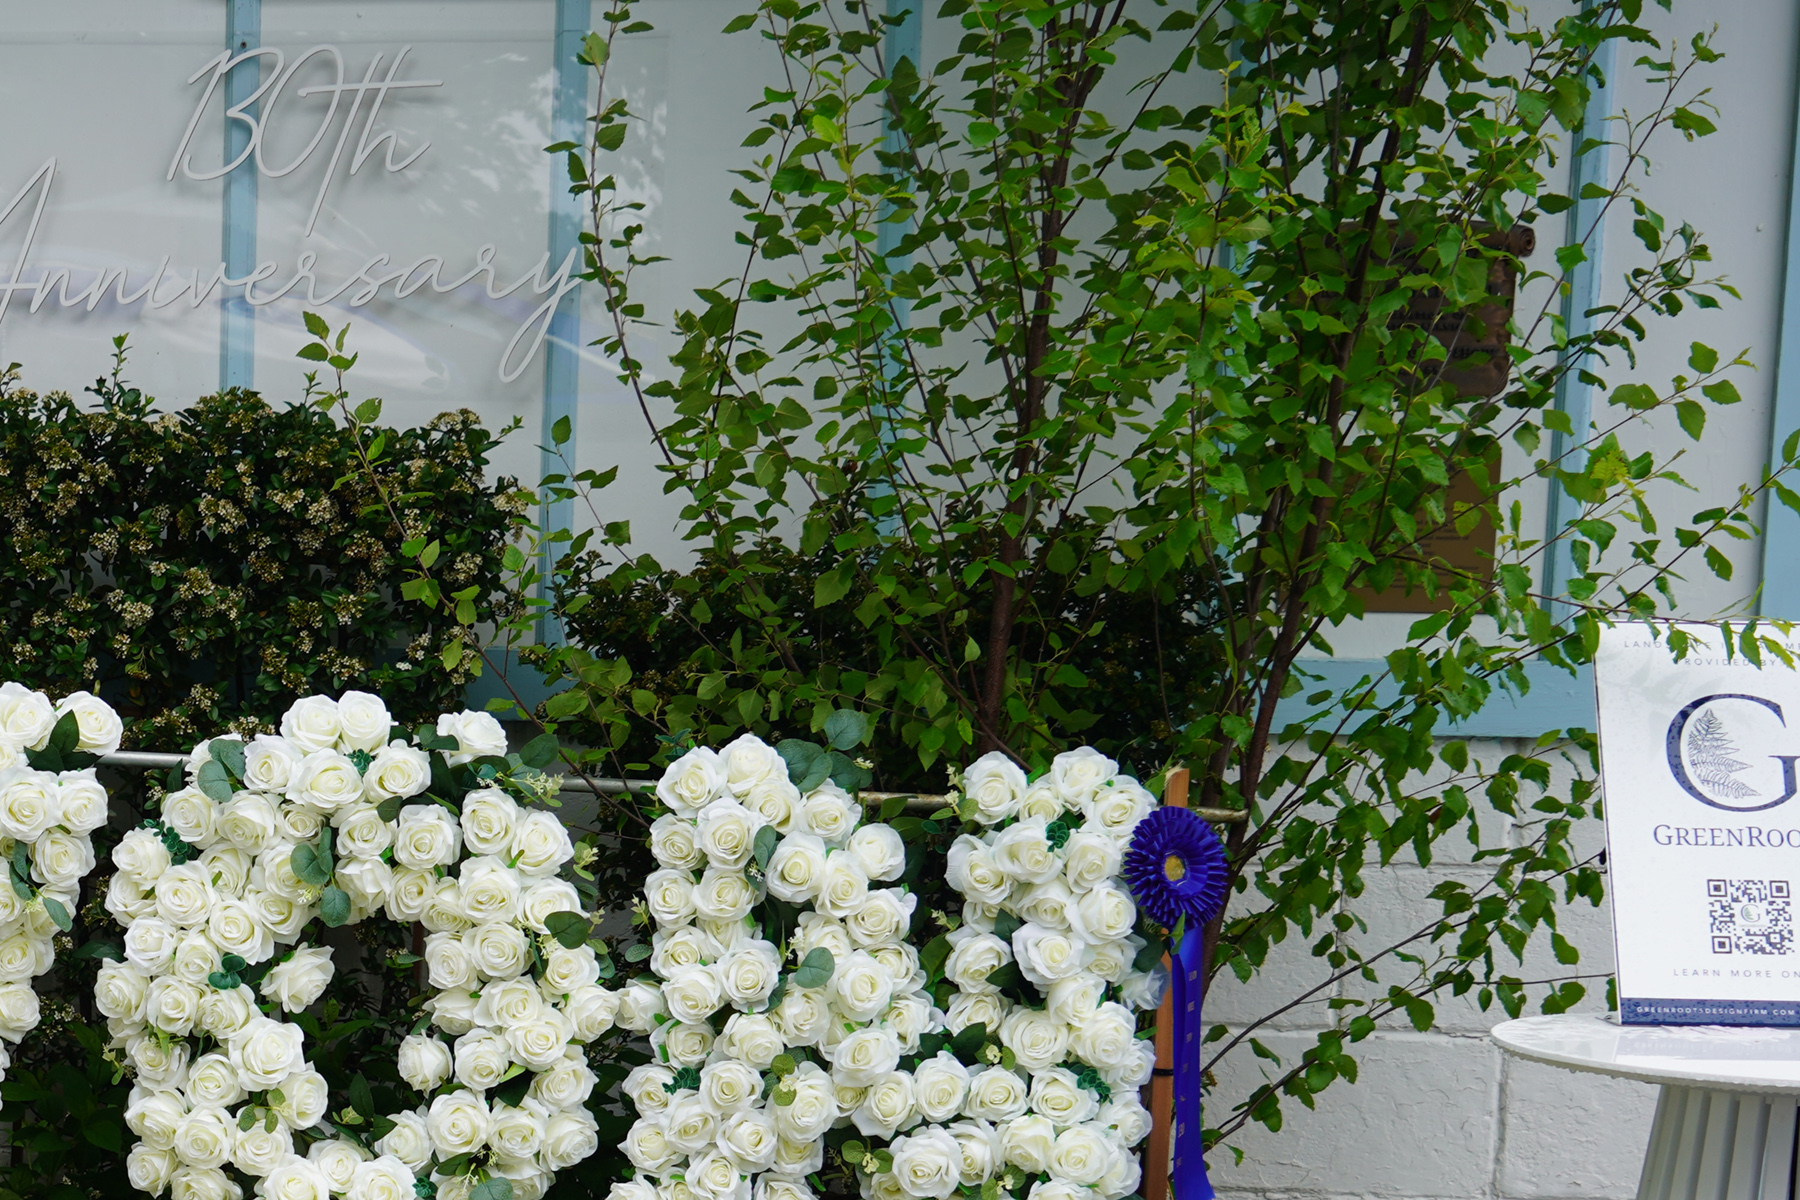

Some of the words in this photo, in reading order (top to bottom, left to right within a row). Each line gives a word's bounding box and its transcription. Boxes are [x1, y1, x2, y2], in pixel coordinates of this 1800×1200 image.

[1678, 658, 1750, 666] ROVIDED
[1673, 968, 1721, 977] LEARN
[1730, 969, 1772, 978] MORE
[1636, 1006, 1796, 1016] GREENROOTSDESIGNFIRM.COM
